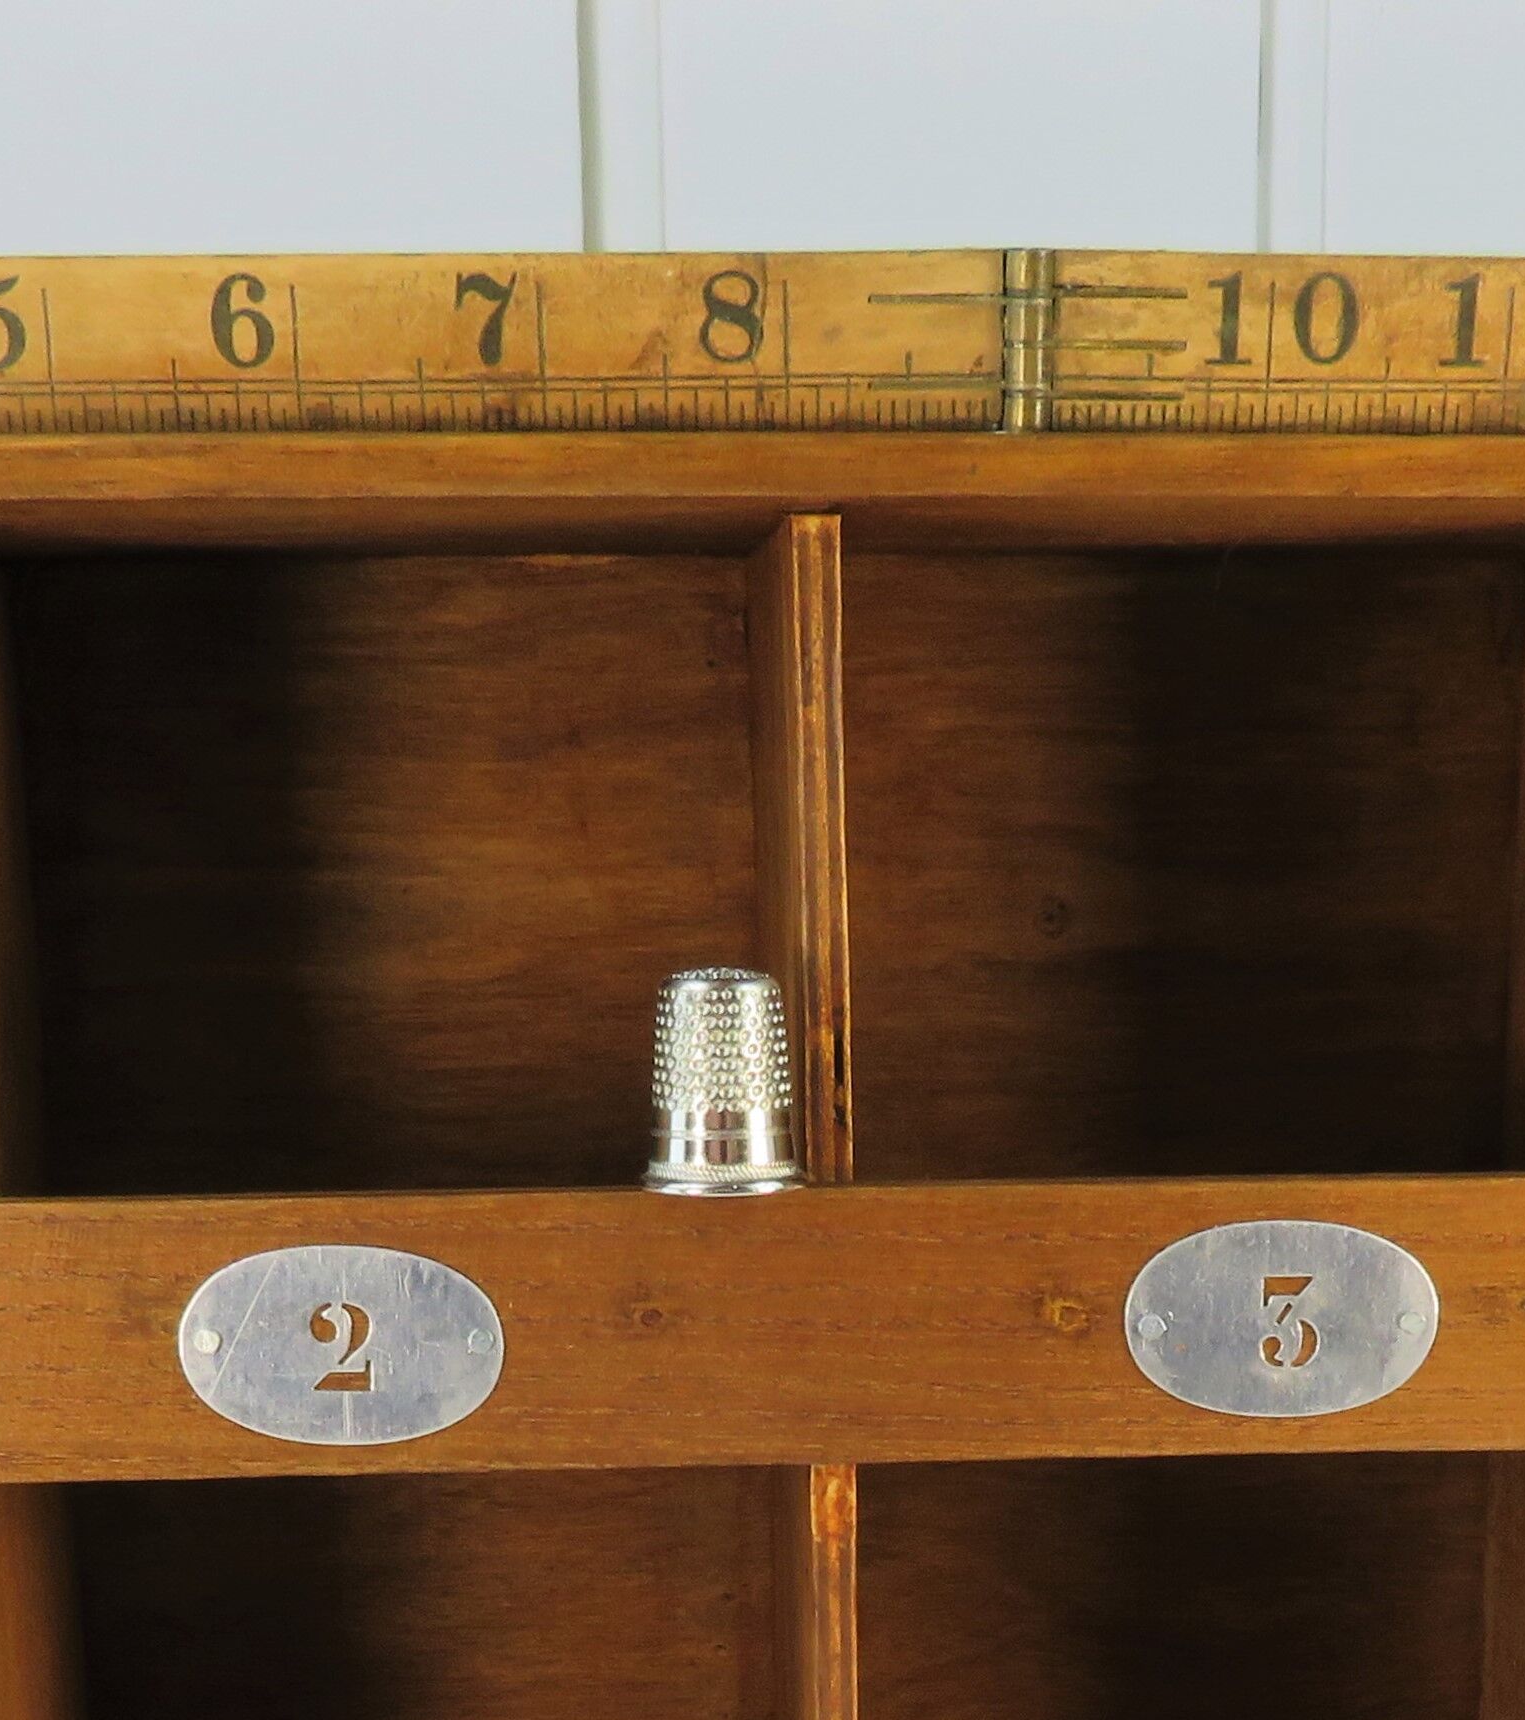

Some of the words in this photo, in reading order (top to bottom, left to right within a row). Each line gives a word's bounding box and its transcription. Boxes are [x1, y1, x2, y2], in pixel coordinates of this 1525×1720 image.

[210, 273, 275, 368] 6
[455, 271, 517, 366] 7
[699, 270, 762, 362] 8
[309, 1301, 375, 1392] 2
[1259, 1275, 1320, 1368] 3
